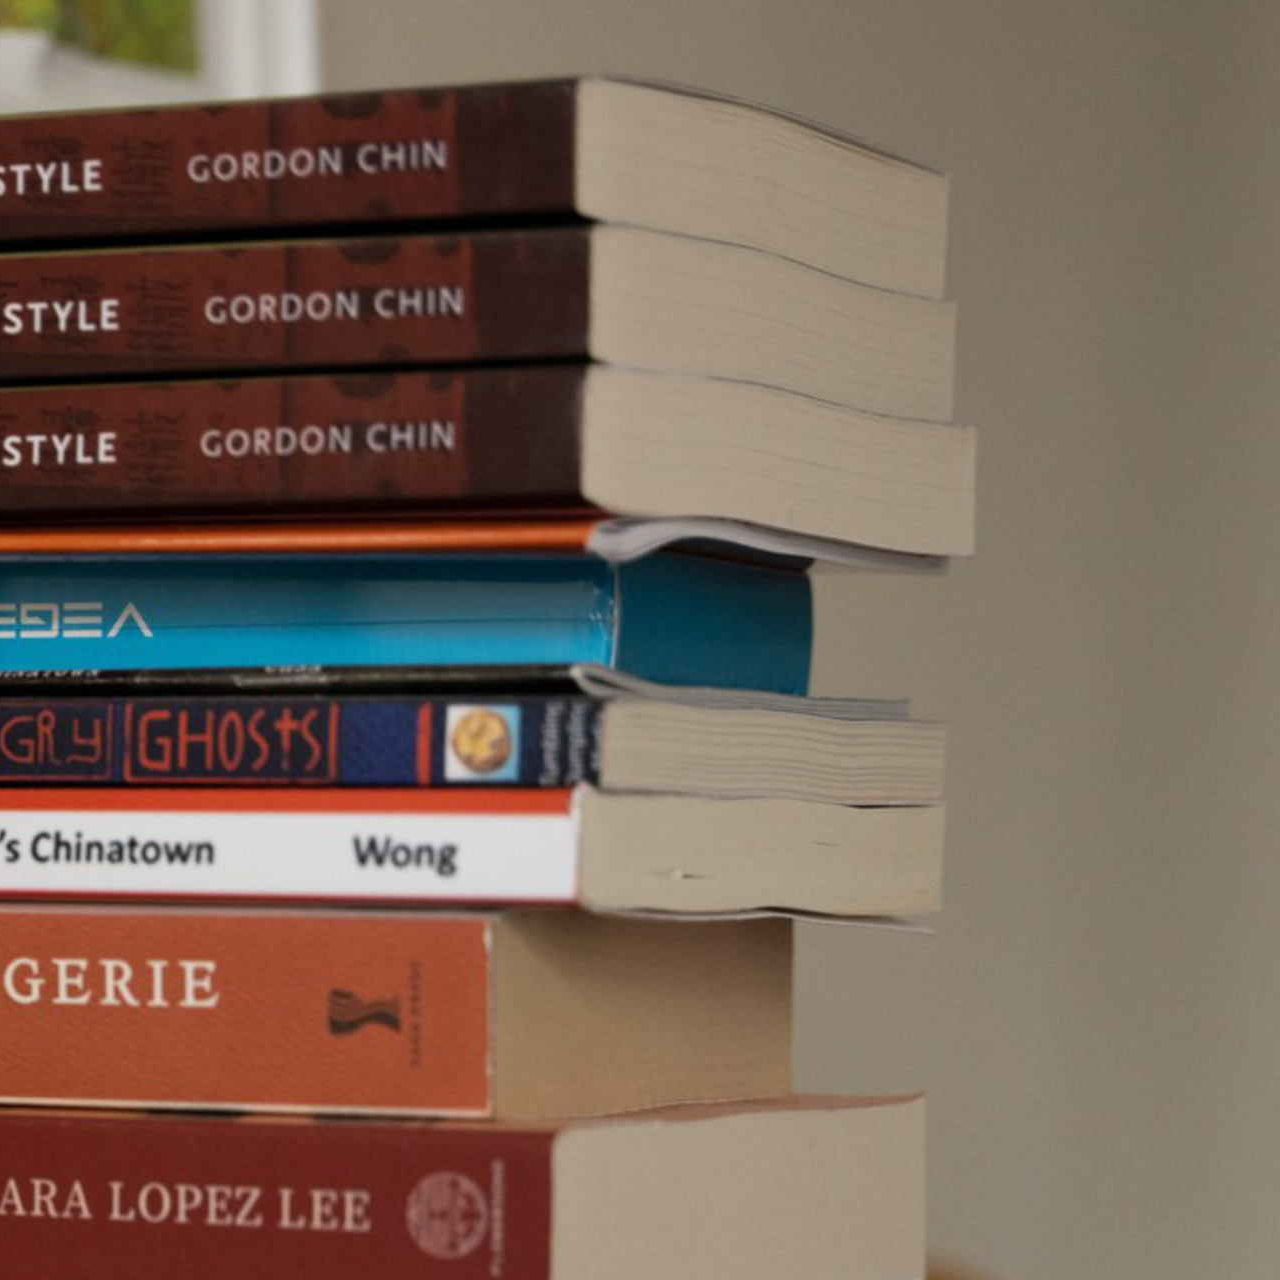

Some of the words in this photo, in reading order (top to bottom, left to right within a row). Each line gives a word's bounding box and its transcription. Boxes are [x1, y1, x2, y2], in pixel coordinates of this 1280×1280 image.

[186, 146, 342, 183] GORDON
[355, 139, 449, 174] CHIN
[1, 298, 121, 335] STYLE
[203, 291, 360, 325] GORDON
[373, 284, 466, 318] CHIN
[1, 431, 118, 467] STYLE
[198, 424, 353, 458] GORDON
[364, 420, 457, 452] CHIN
[138, 708, 323, 772] GHOSTS
[29, 832, 216, 867] Chinatown
[352, 836, 459, 877] Wong
[108, 1181, 265, 1229] LOPEZ
[278, 1189, 372, 1233] LEE
